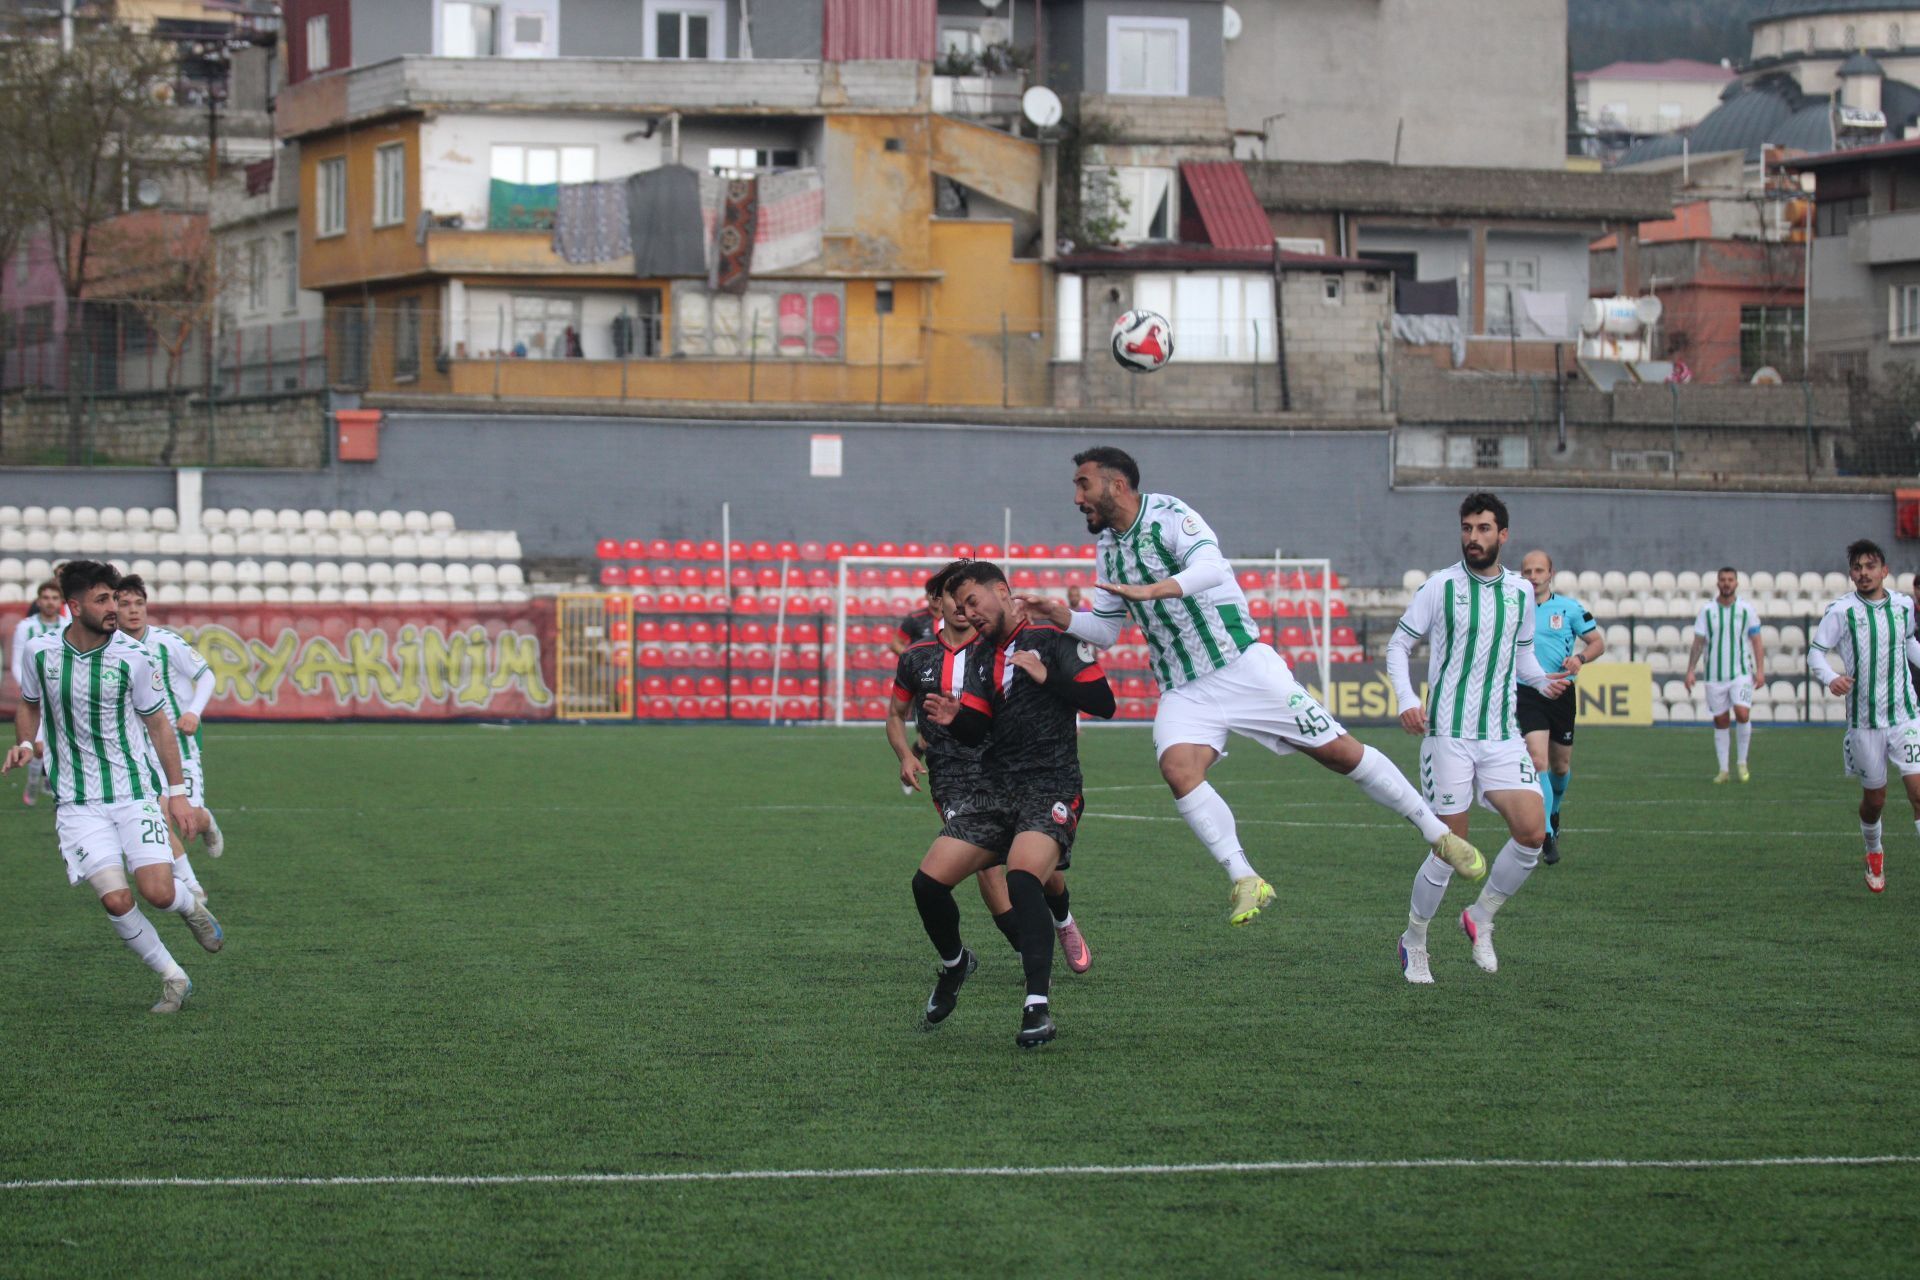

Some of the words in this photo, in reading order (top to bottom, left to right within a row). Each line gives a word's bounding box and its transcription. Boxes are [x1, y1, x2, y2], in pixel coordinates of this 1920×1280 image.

[1295, 705, 1330, 737] 45
[1903, 744, 1920, 763] 32
[141, 819, 165, 845] 28
